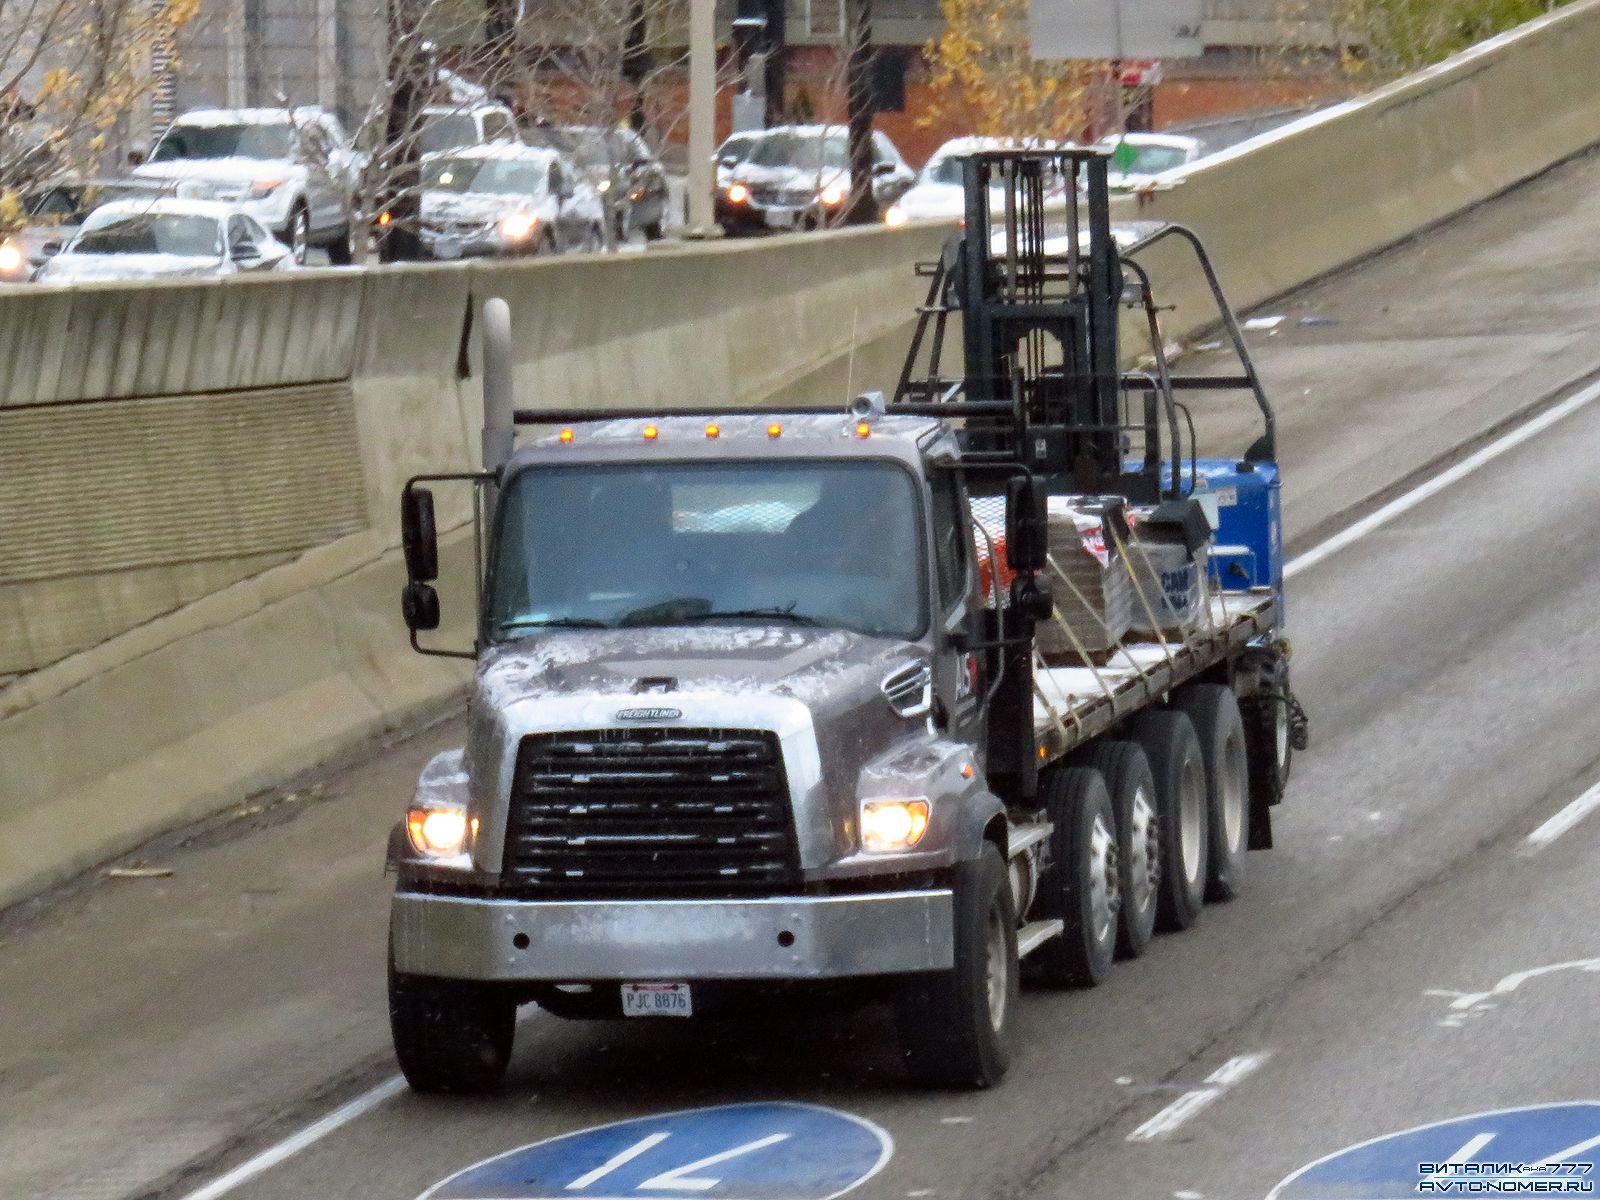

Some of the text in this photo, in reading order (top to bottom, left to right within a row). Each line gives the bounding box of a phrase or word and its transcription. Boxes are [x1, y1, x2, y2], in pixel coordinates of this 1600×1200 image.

[617, 708, 681, 719] FREIGHTLINER
[626, 992, 687, 1009] PJC 8876
